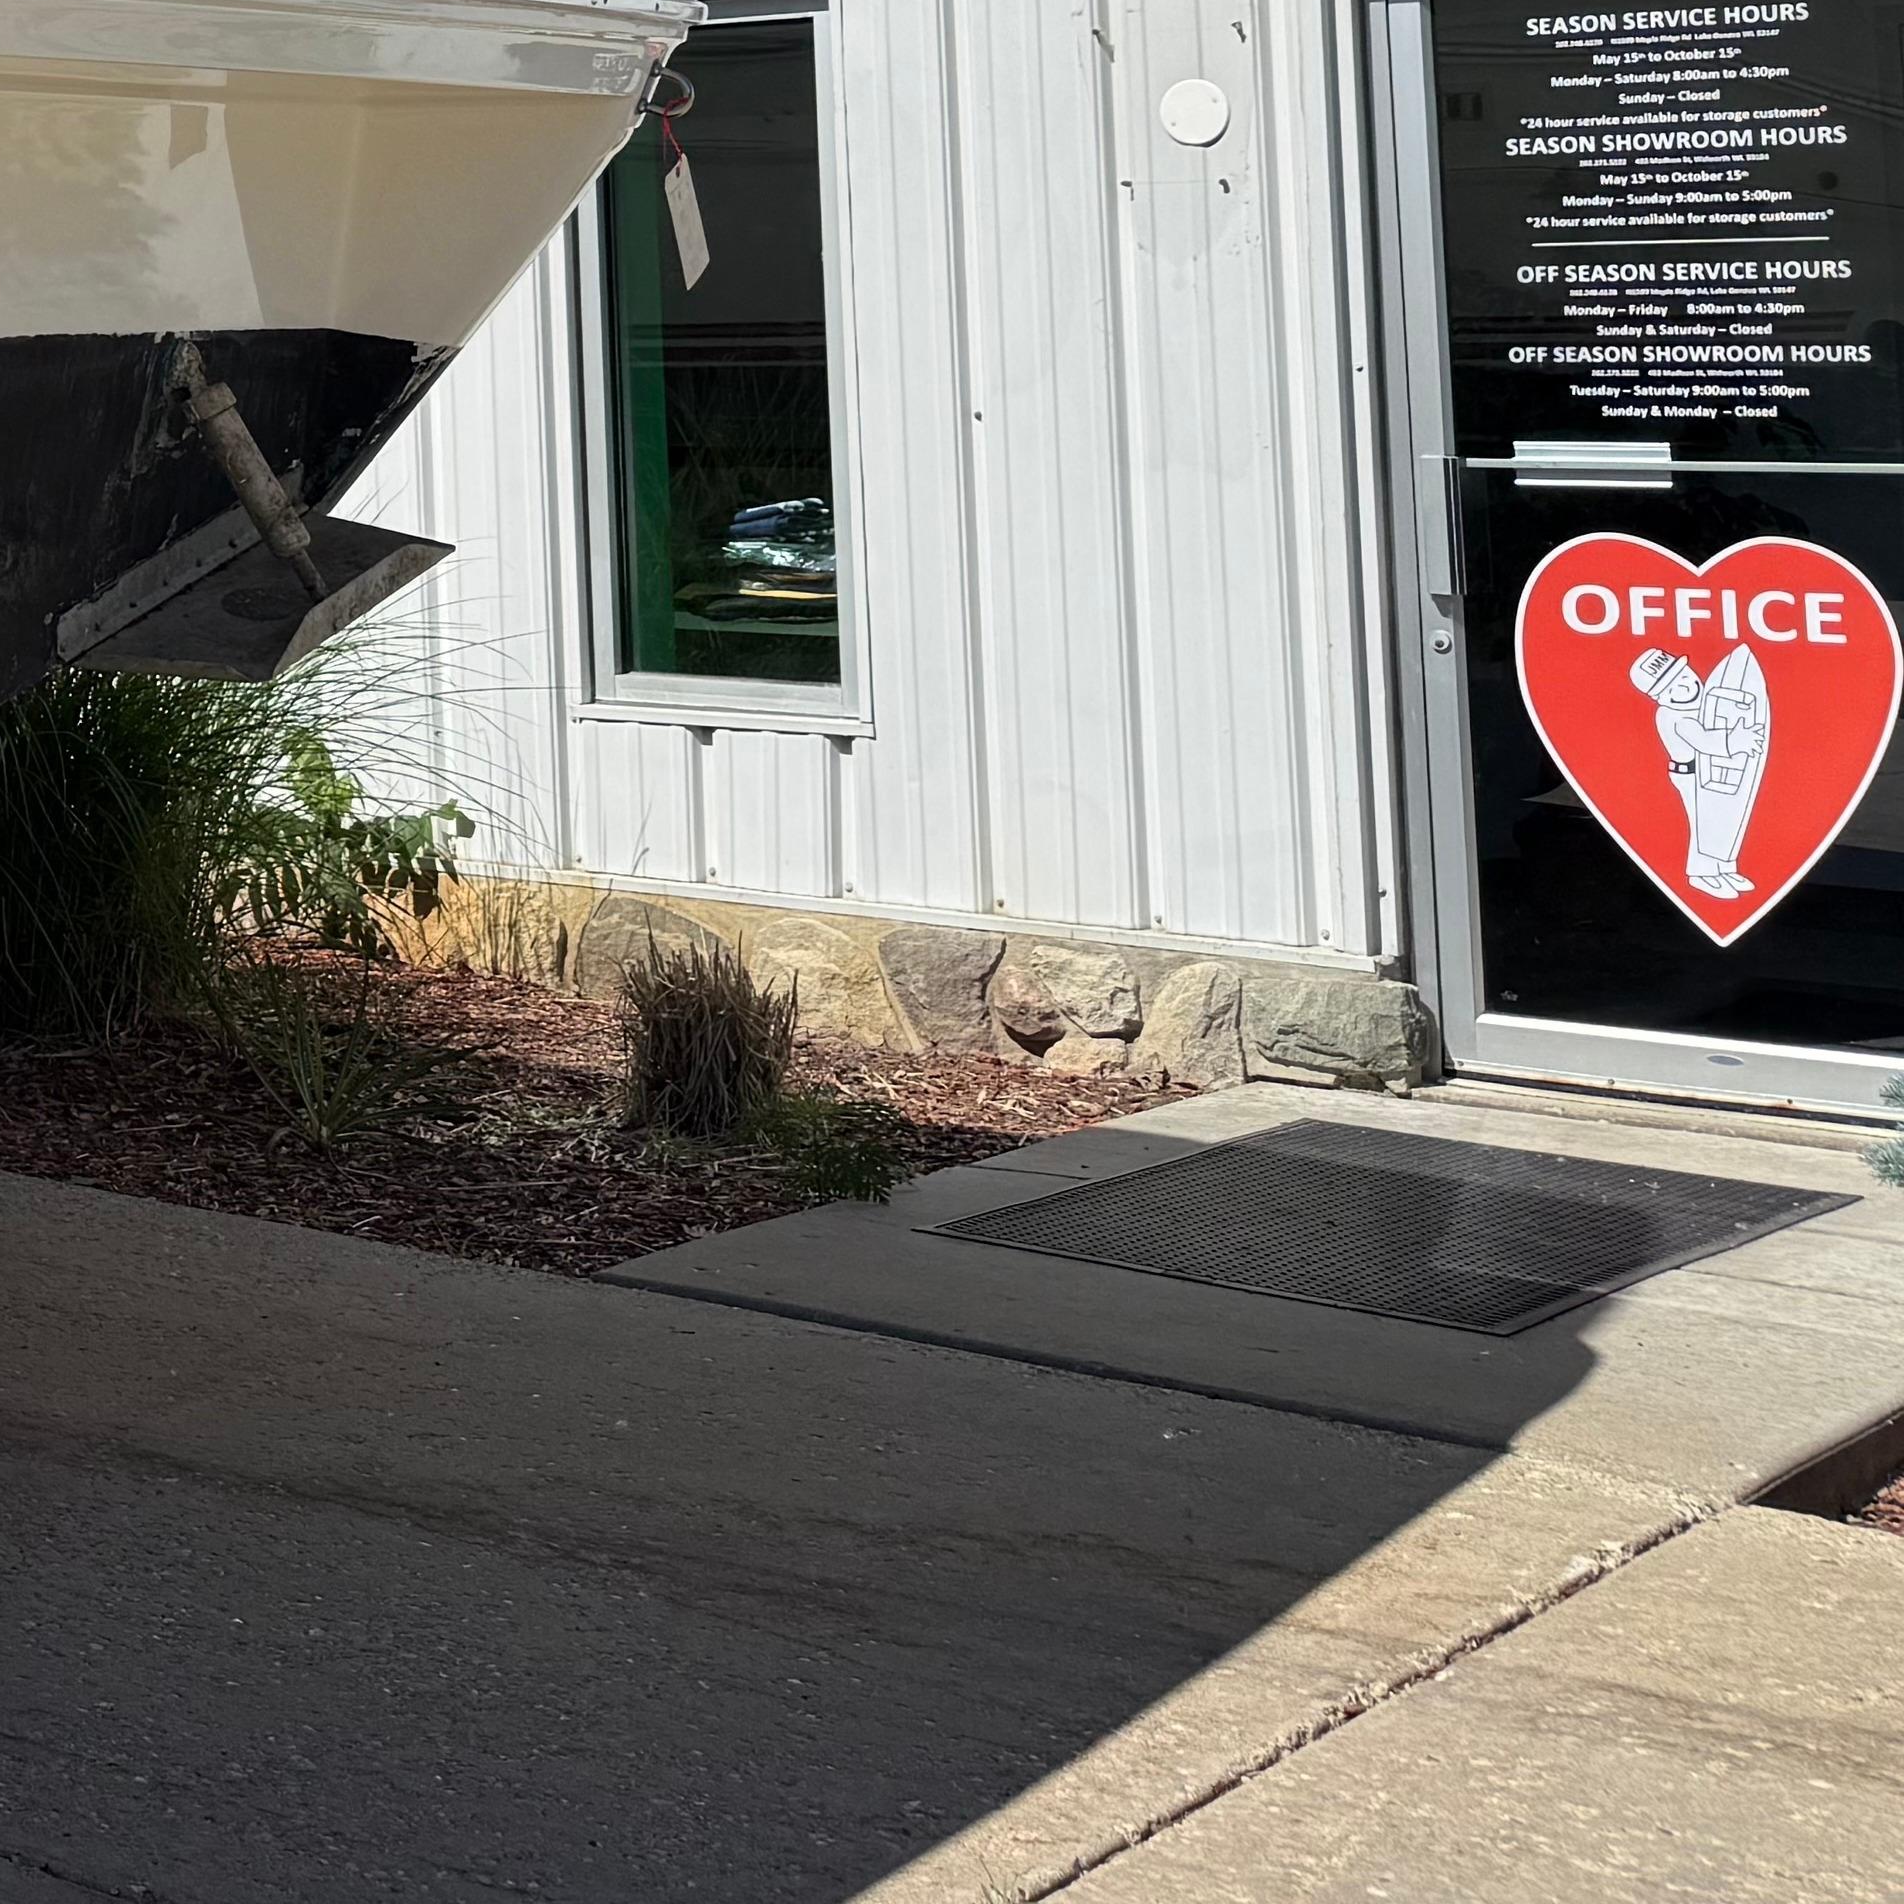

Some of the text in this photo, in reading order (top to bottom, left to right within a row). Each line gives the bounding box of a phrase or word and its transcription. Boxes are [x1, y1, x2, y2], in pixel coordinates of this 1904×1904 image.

[1526, 2, 1809, 36] SEASON SERVICE HOURS
[1593, 54, 1621, 65] May
[1648, 51, 1662, 62] to
[1664, 49, 1716, 61] October
[1551, 75, 1602, 88] Monday
[1614, 71, 1671, 85] Saturday
[1673, 70, 1721, 82] 8:00am
[1723, 69, 1737, 80] to
[1739, 66, 1789, 78] 4:30pm
[1618, 92, 1665, 105] Sunday
[1678, 89, 1721, 101] Closed
[1545, 116, 1575, 128] hour
[1576, 115, 1620, 127] service
[1622, 112, 1678, 124] available
[1681, 110, 1698, 122] for
[1700, 109, 1750, 122] storage
[1505, 125, 1847, 156] SEASON SHOWROOM HOURS
[1600, 174, 1628, 186] May
[1655, 172, 1669, 183] to
[1671, 170, 1723, 182] October
[1562, 195, 1614, 208] Monday
[1627, 194, 1673, 207] Sunday
[1675, 193, 1722, 204] 9:00am
[1724, 192, 1739, 203] to
[1742, 190, 1792, 203] 5:00pm
[1551, 217, 1580, 227] hour
[1582, 216, 1625, 226] service
[1628, 212, 1685, 225] available
[1687, 212, 1706, 223] for
[1708, 212, 1757, 223] storage
[1516, 260, 1852, 284] OFF SEASON SERVICE HOURS
[1564, 304, 1616, 317] Monday
[1628, 304, 1668, 316] Friday
[1686, 303, 1734, 315] 8:00am
[1737, 303, 1752, 314] to
[1754, 302, 1805, 315] 4:30pm
[1596, 324, 1643, 337] Sunday
[1645, 324, 1657, 336] &
[1659, 324, 1716, 337] Saturday
[1729, 323, 1772, 335] Closed
[1508, 345, 1872, 364] OFF SEASON SHOWROOM HOURS
[1569, 385, 1620, 398] Tuesday
[1633, 385, 1691, 398] Saturday
[1692, 385, 1740, 397] 9:00am
[1742, 385, 1757, 397] to
[1760, 385, 1810, 398] 5:00pm
[1602, 405, 1648, 418] Sunday
[1651, 406, 1662, 417] &
[1664, 405, 1717, 418] Monday
[1734, 405, 1778, 417] Closed
[1561, 584, 1847, 645] OFFICE
